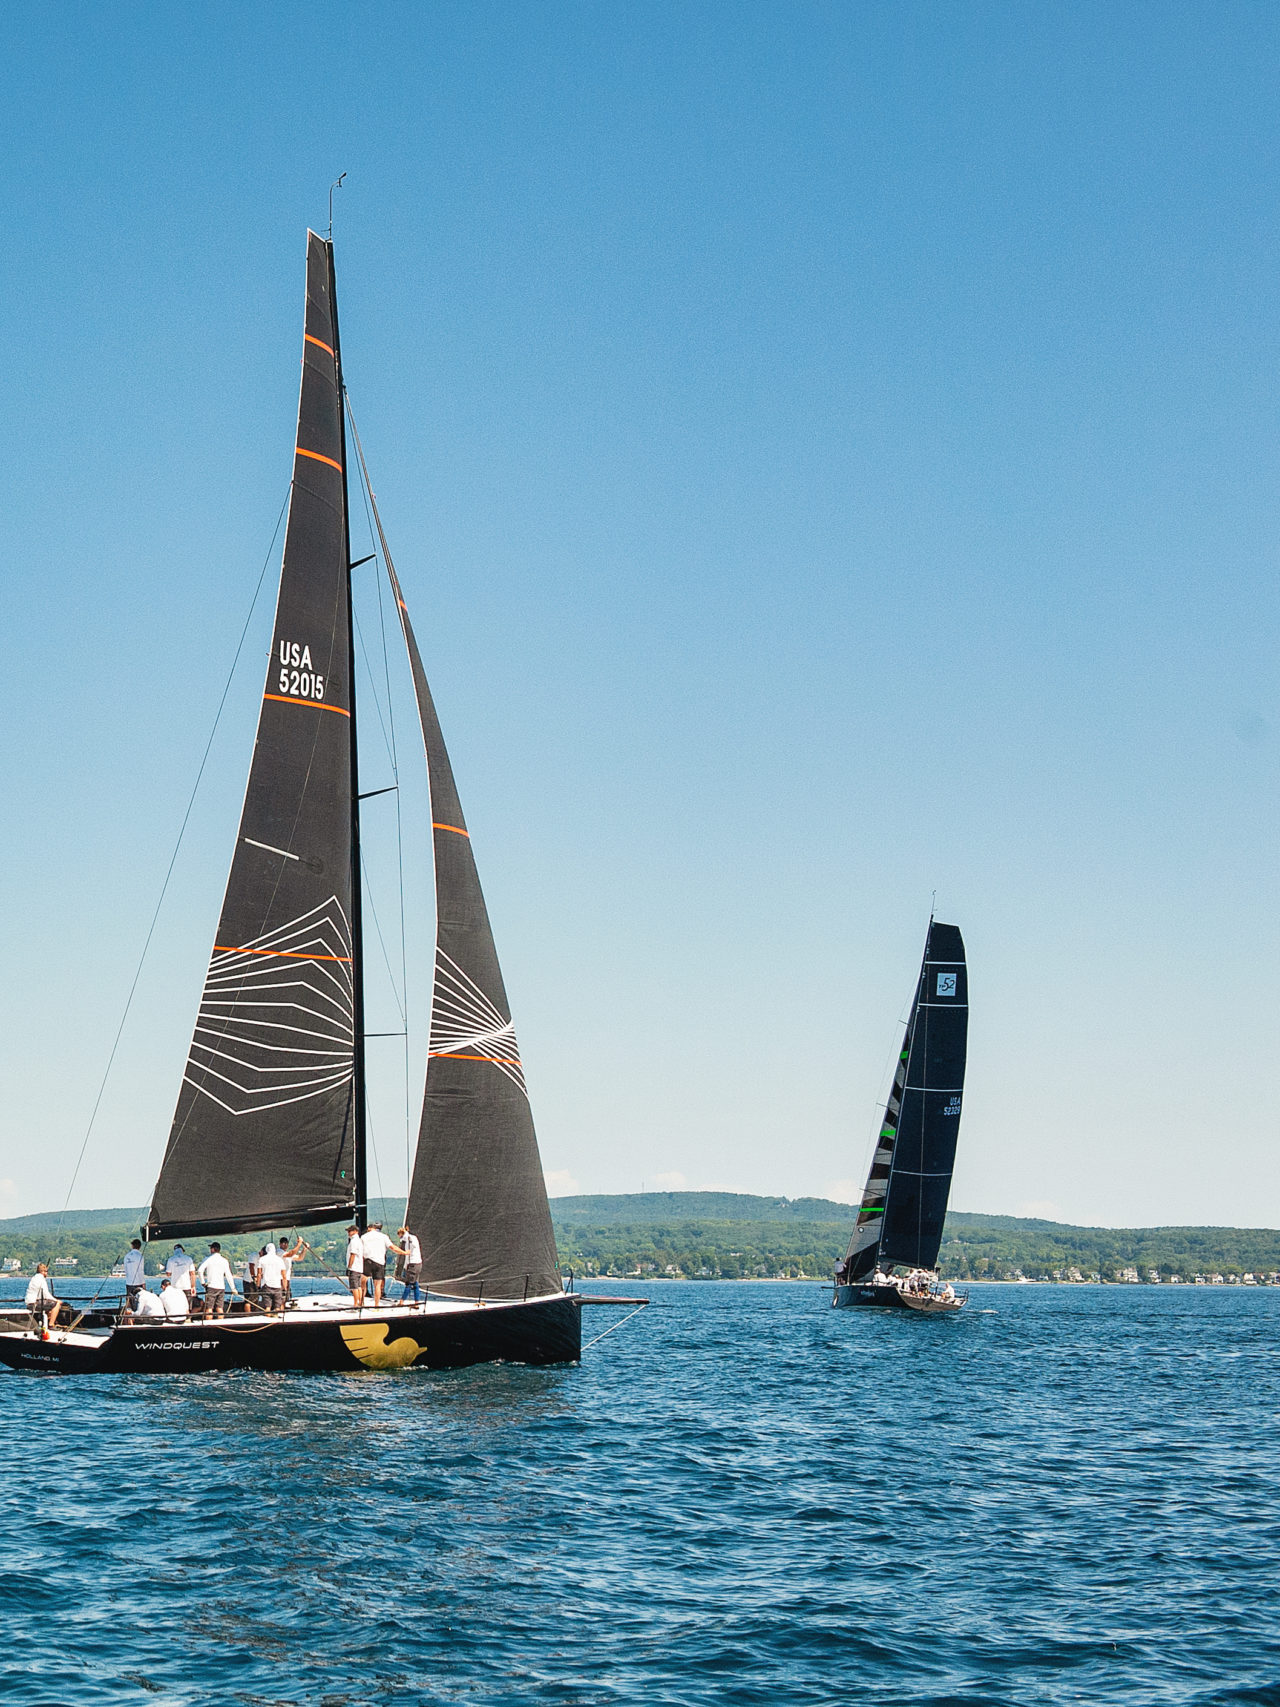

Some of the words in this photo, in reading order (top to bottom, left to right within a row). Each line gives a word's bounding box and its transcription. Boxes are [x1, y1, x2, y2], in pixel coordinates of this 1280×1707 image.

[280, 640, 312, 670] USA
[279, 668, 324, 699] 52015
[950, 1096, 961, 1106] USA
[135, 1341, 220, 1350] WINDQUEST
